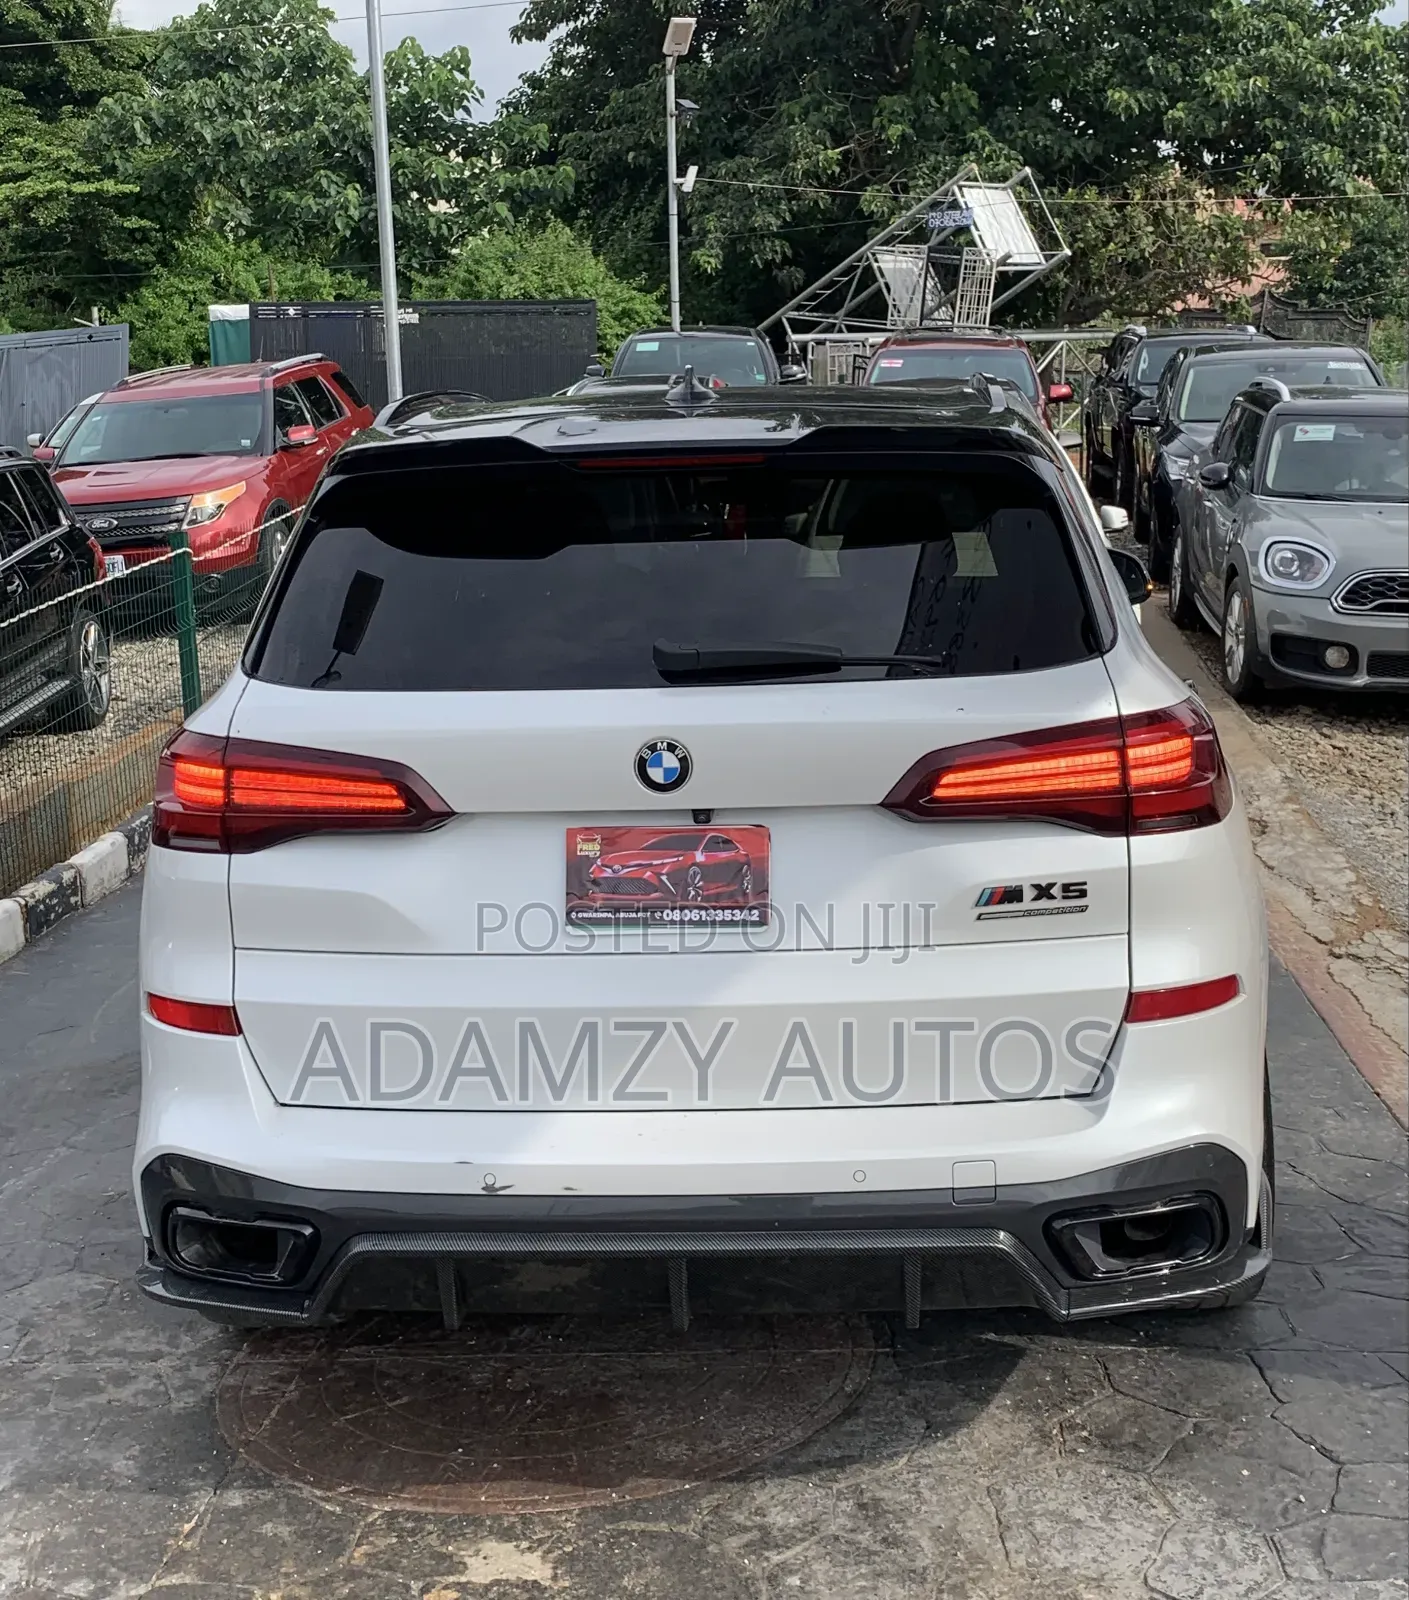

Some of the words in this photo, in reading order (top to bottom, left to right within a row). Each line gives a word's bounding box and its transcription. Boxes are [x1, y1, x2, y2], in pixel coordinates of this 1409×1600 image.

[641, 741, 686, 760] BMW
[662, 909, 760, 921] 08061335342
[1024, 905, 1088, 917] competition
